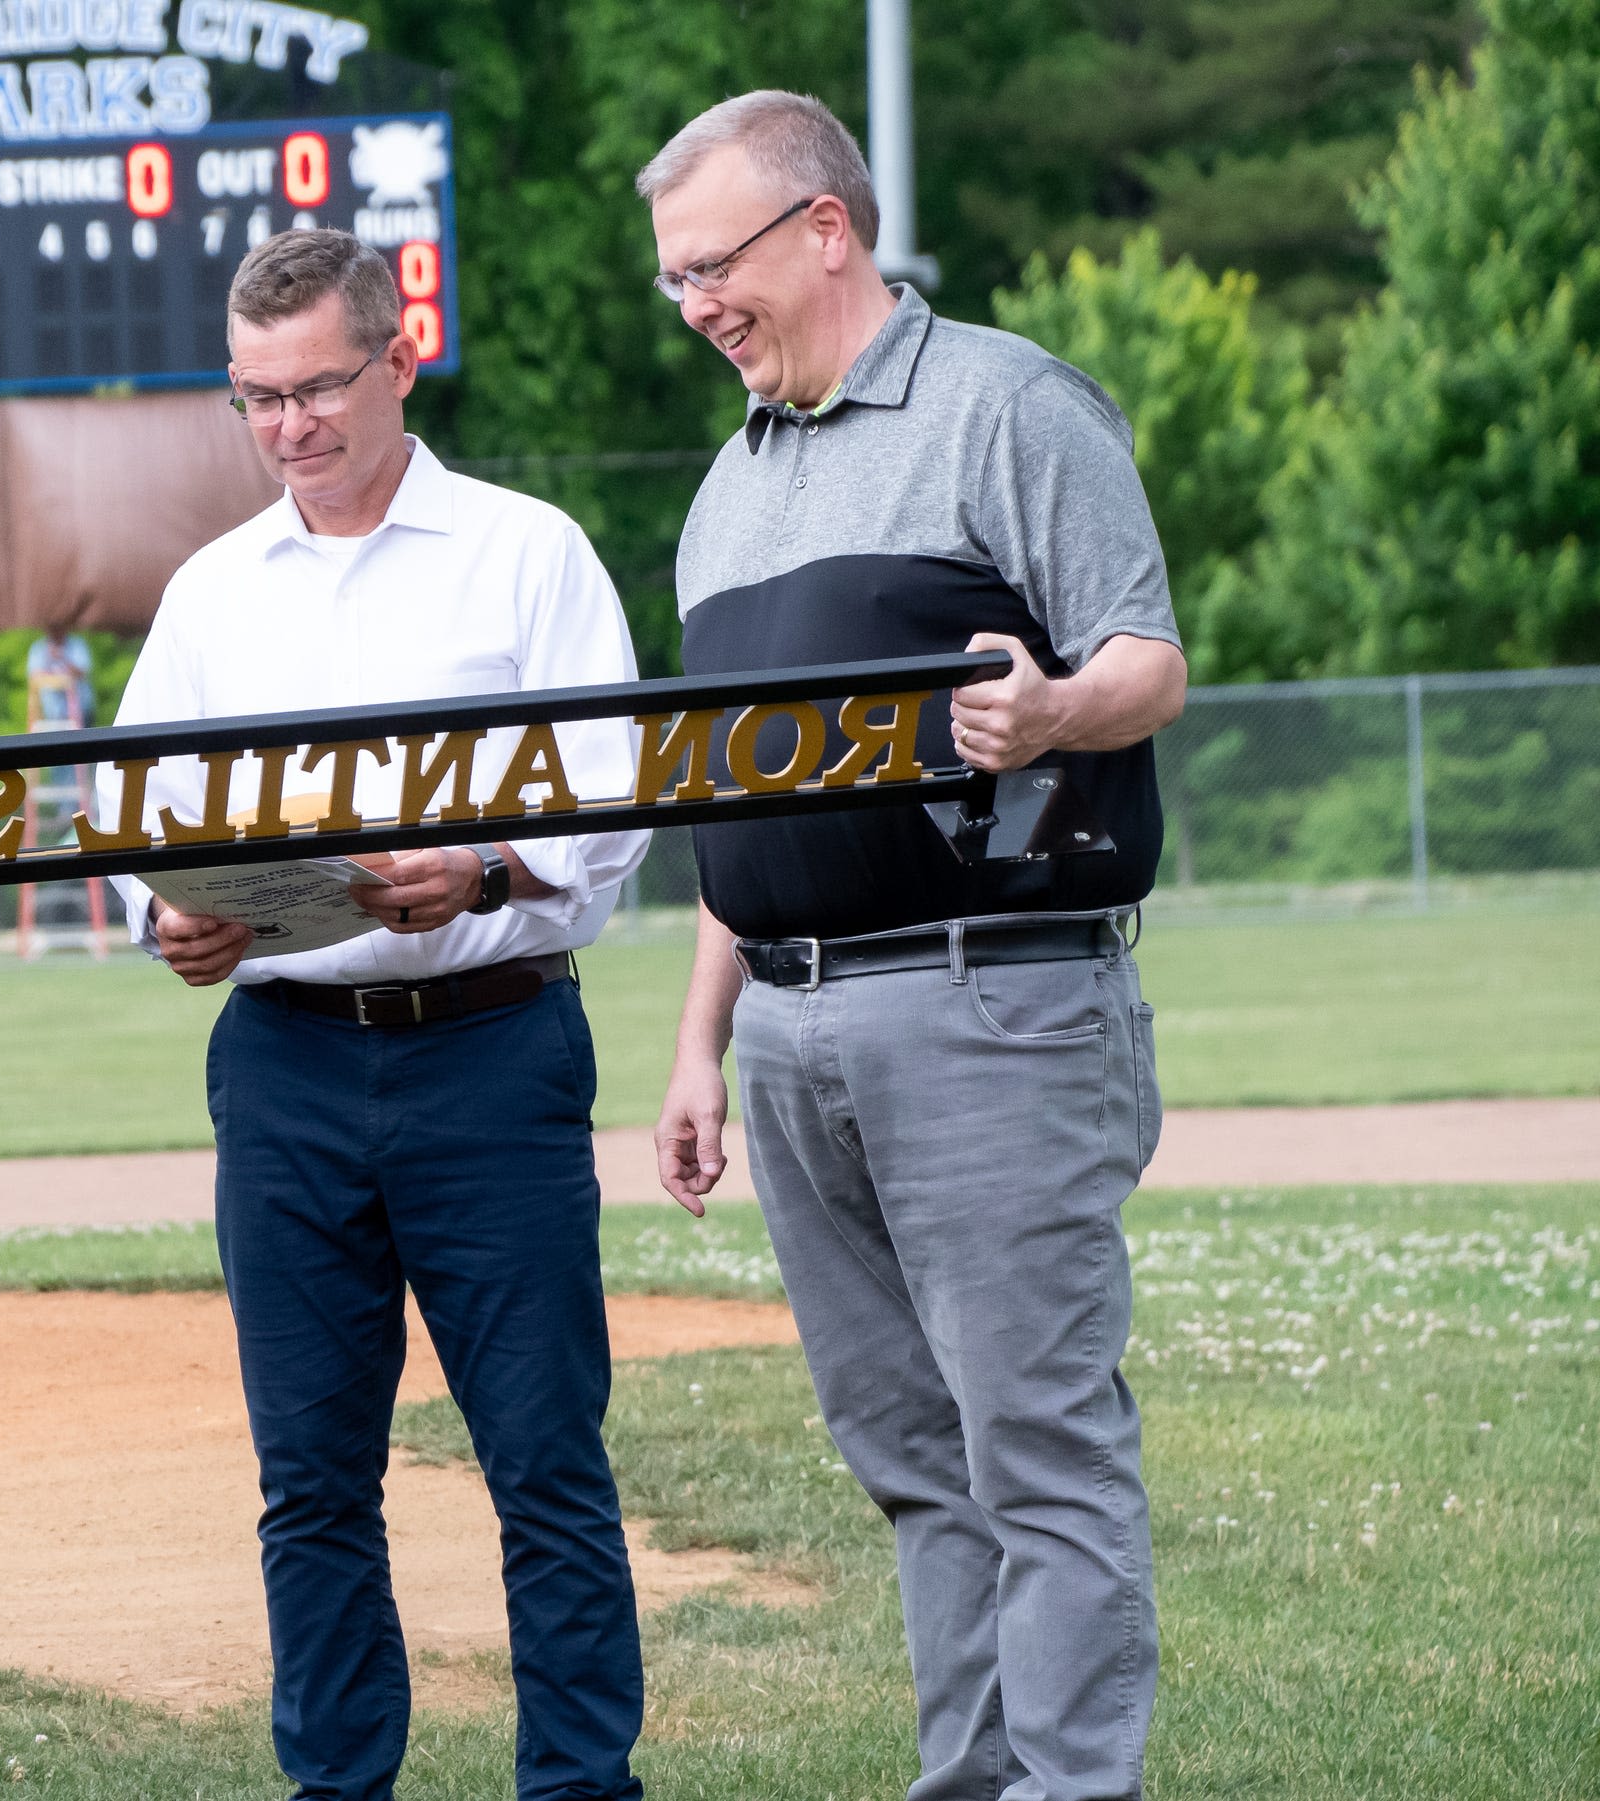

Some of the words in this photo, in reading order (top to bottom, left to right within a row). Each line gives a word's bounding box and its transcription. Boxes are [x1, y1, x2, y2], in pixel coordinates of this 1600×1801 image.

[177, 0, 369, 84] CITY
[127, 141, 174, 218] 0
[197, 149, 277, 199] OUT
[283, 131, 330, 207] 0
[38, 221, 64, 263] 4
[201, 207, 230, 257] 7
[400, 240, 441, 301] 0
[403, 300, 444, 362] 0
